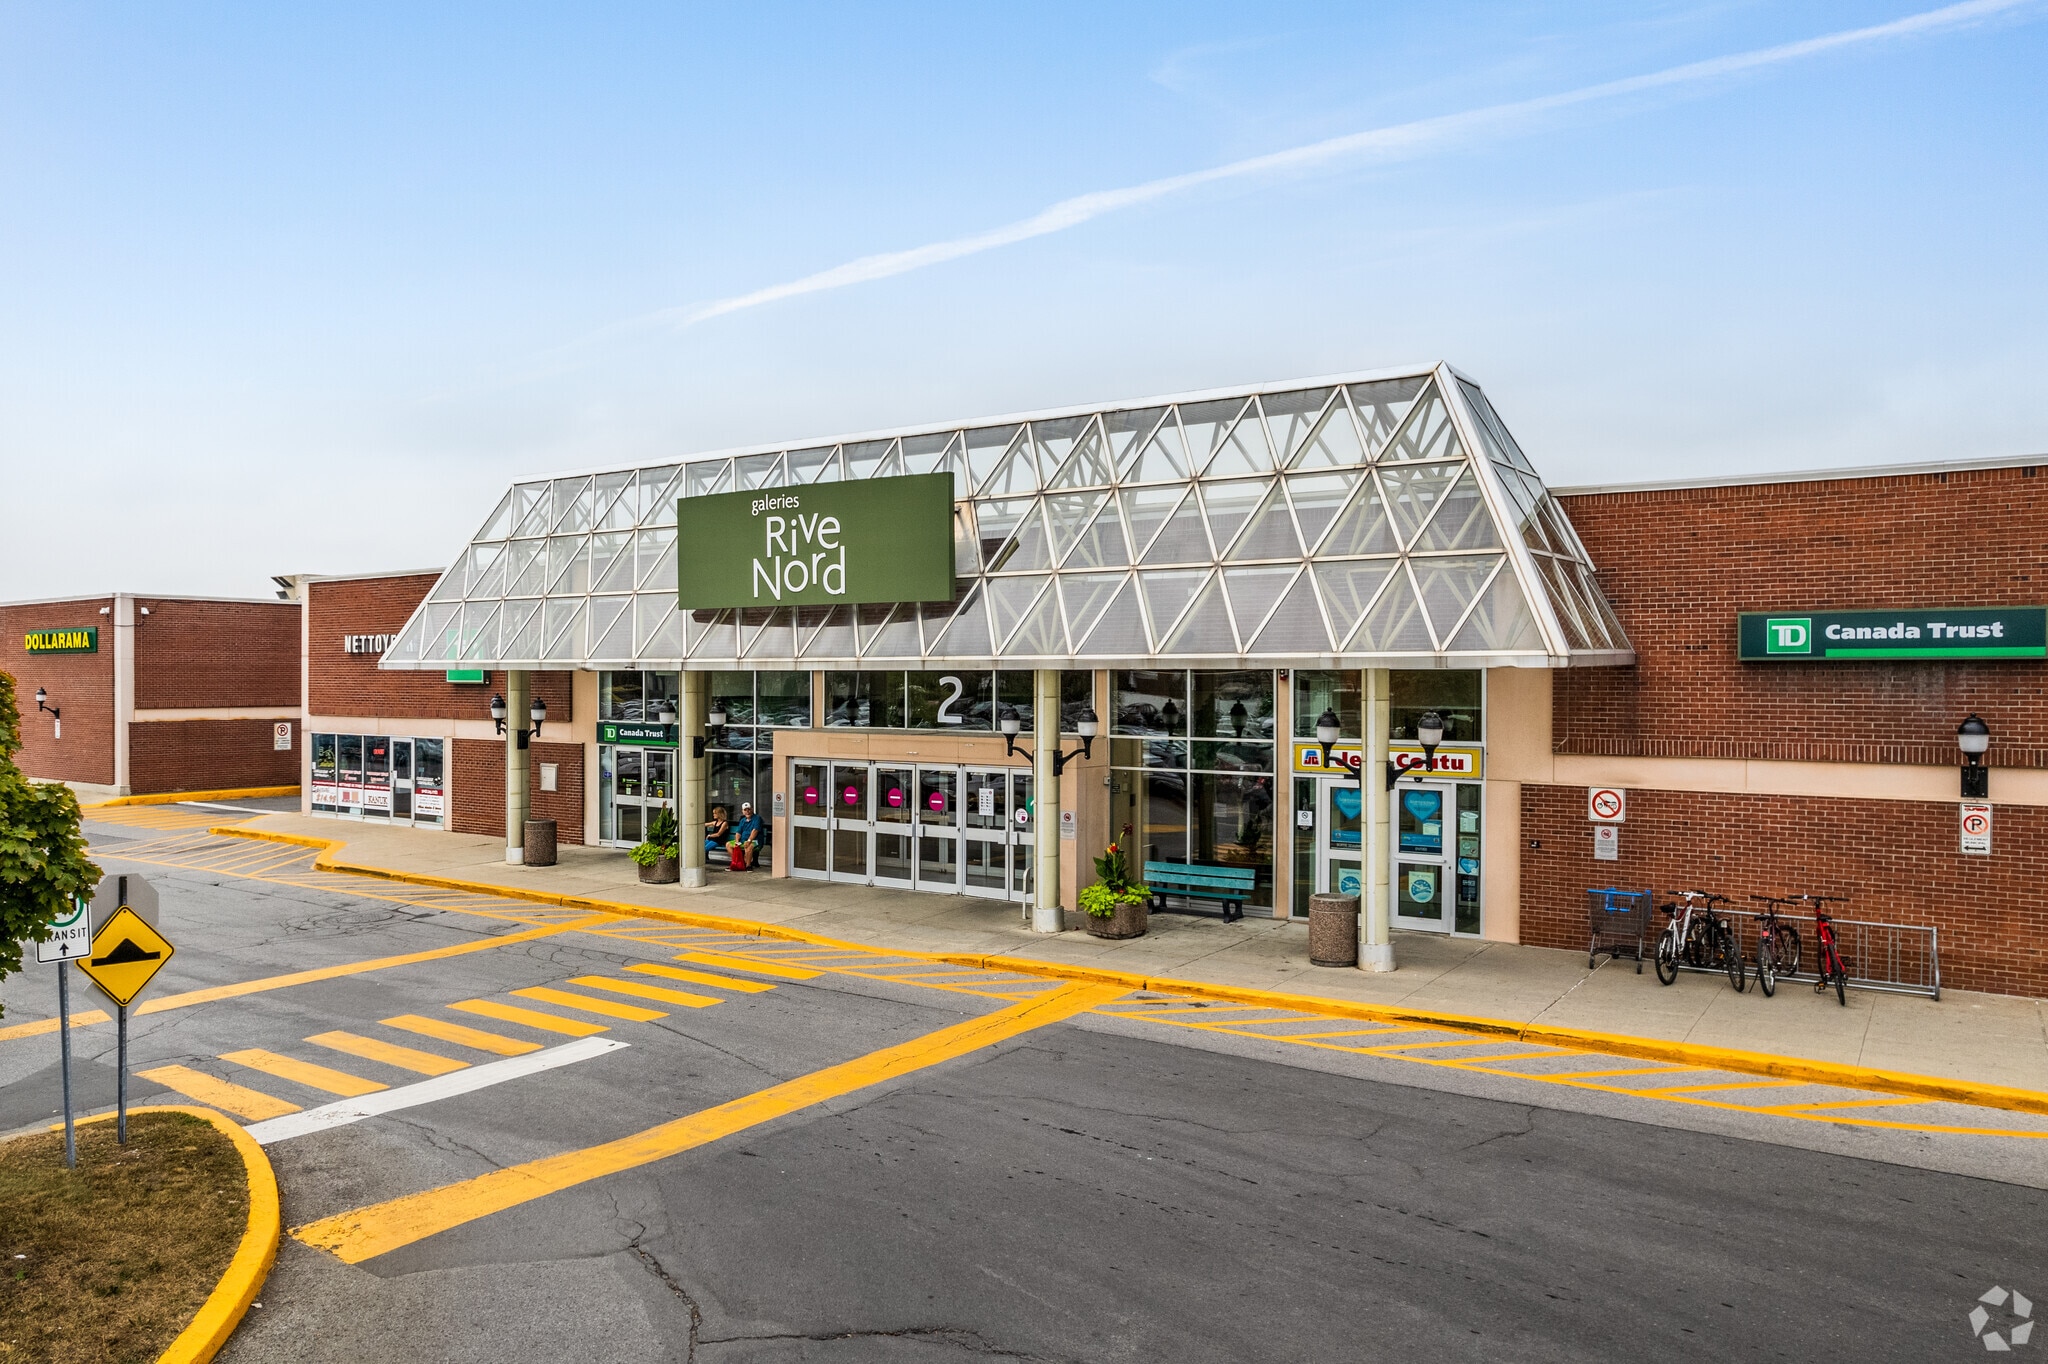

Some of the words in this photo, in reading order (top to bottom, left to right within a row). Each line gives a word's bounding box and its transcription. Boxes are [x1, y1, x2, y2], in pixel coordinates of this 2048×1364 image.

[751, 493, 800, 516] galeries
[766, 513, 841, 558] Rive
[752, 546, 846, 601] Nord
[25, 631, 90, 650] DOLLARAMA
[1771, 625, 1806, 647] TD
[1825, 621, 1921, 641] Canada
[1926, 621, 2004, 640] Trust
[937, 675, 964, 724] 2
[605, 728, 616, 739] TD
[619, 728, 644, 738] Canada
[644, 729, 664, 738] Trust
[46, 927, 87, 943] ANSIT
